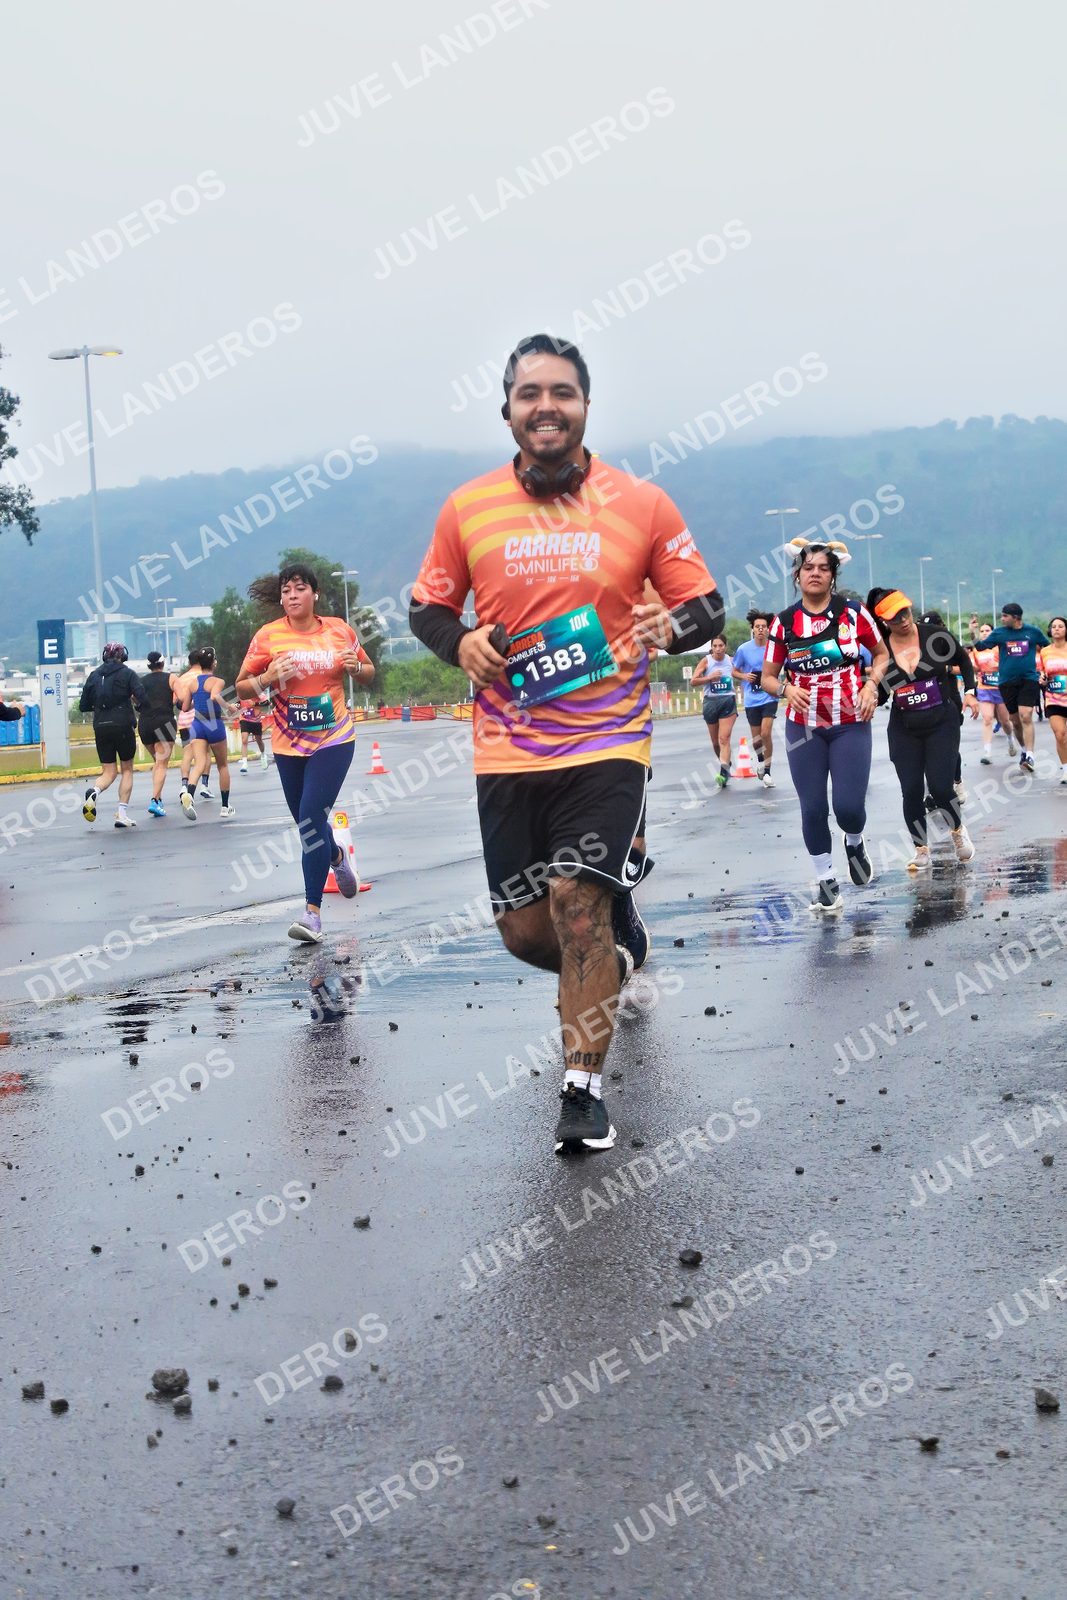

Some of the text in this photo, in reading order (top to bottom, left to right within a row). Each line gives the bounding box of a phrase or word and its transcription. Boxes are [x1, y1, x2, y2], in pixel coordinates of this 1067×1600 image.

[505, 532, 600, 560] CARRERA
[505, 557, 579, 577] OMNILIFE
[569, 612, 590, 632] 10K
[43, 639, 59, 659] E
[510, 631, 545, 655] ARRERA
[525, 643, 587, 682] 1383
[799, 656, 830, 671] 1430
[908, 693, 928, 705] 599
[294, 710, 324, 721] 1614
